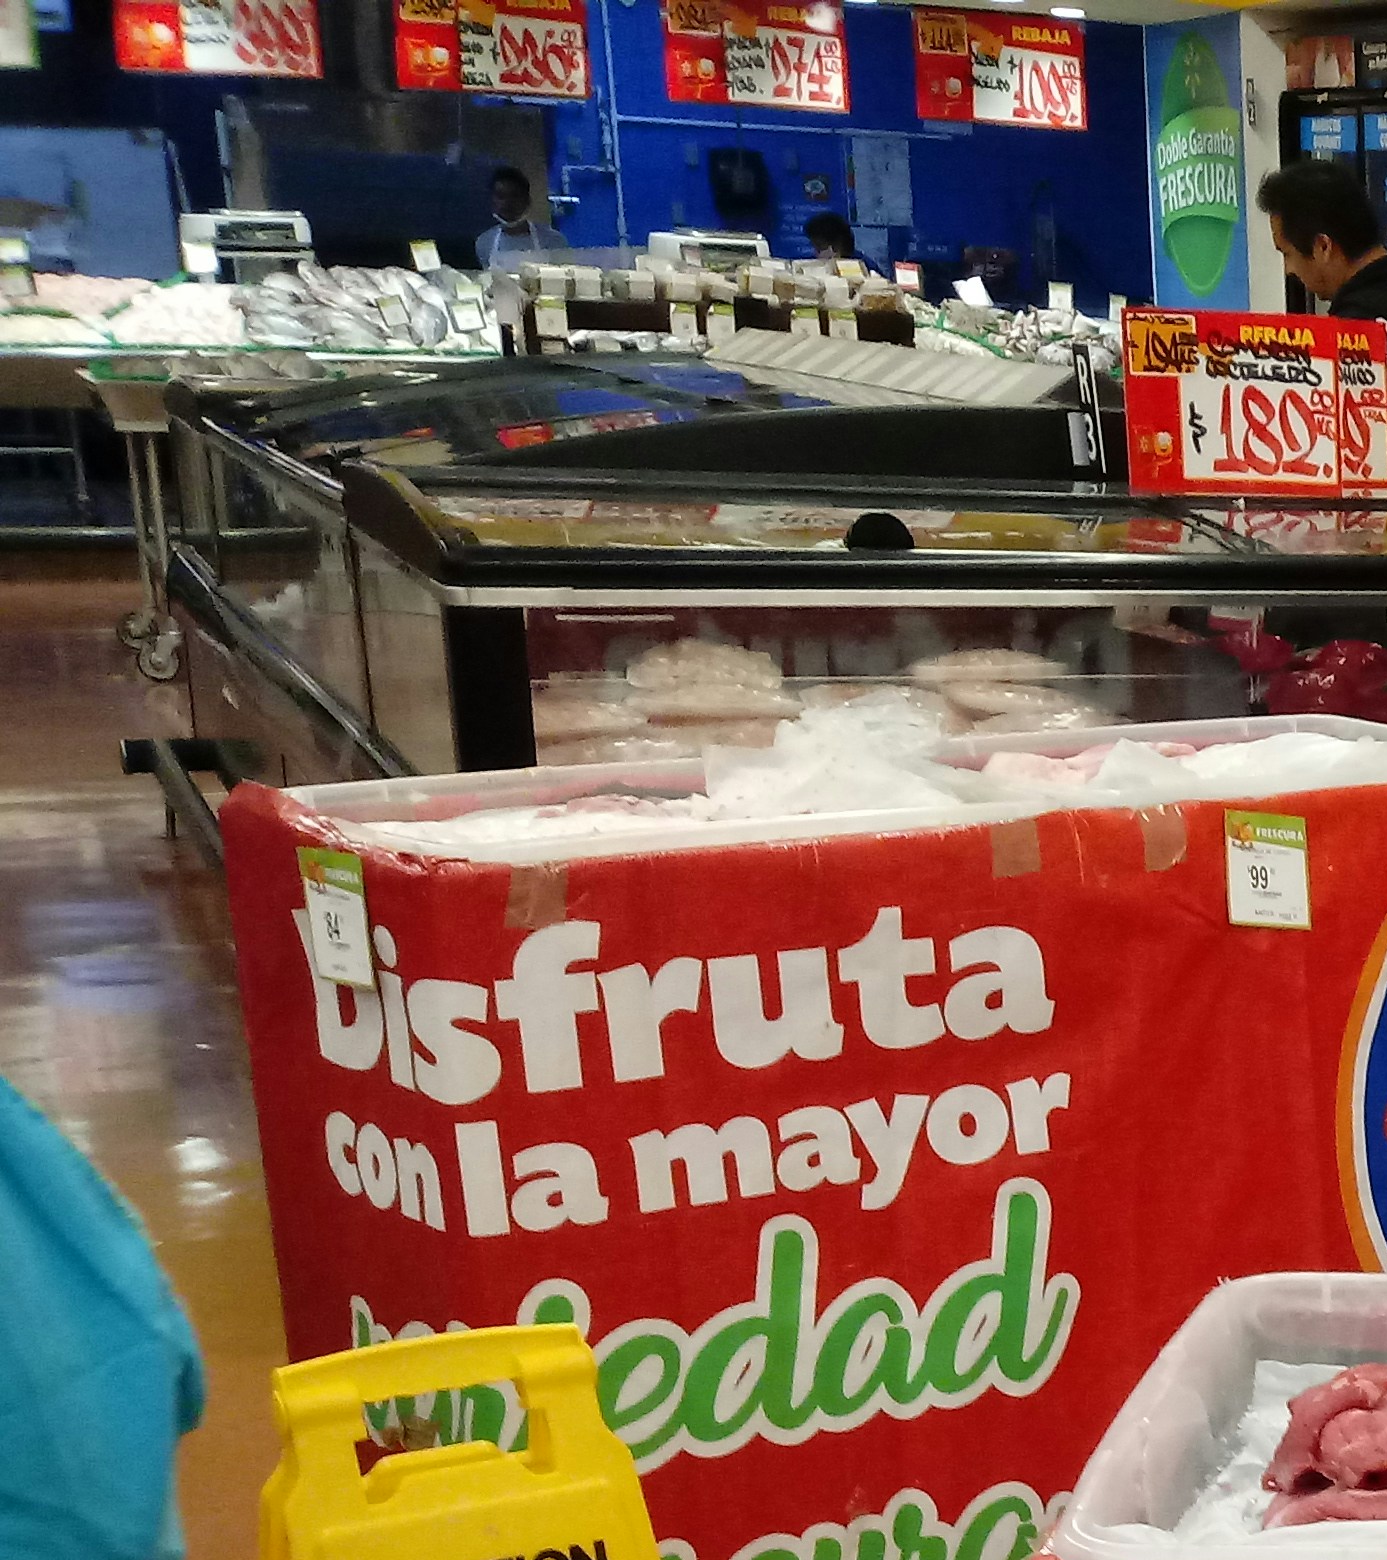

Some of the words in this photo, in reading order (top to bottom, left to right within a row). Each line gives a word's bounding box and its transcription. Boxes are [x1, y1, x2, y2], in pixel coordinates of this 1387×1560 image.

[1157, 131, 1188, 170] Doble
[1189, 127, 1235, 157] Garantía
[1160, 162, 1238, 217] FRESCURA
[1256, 827, 1304, 842] FRESCURA
[1249, 865, 1269, 889] 99
[325, 1110, 446, 1232] con
[454, 1120, 609, 1238] la
[627, 1072, 1071, 1212] mayor
